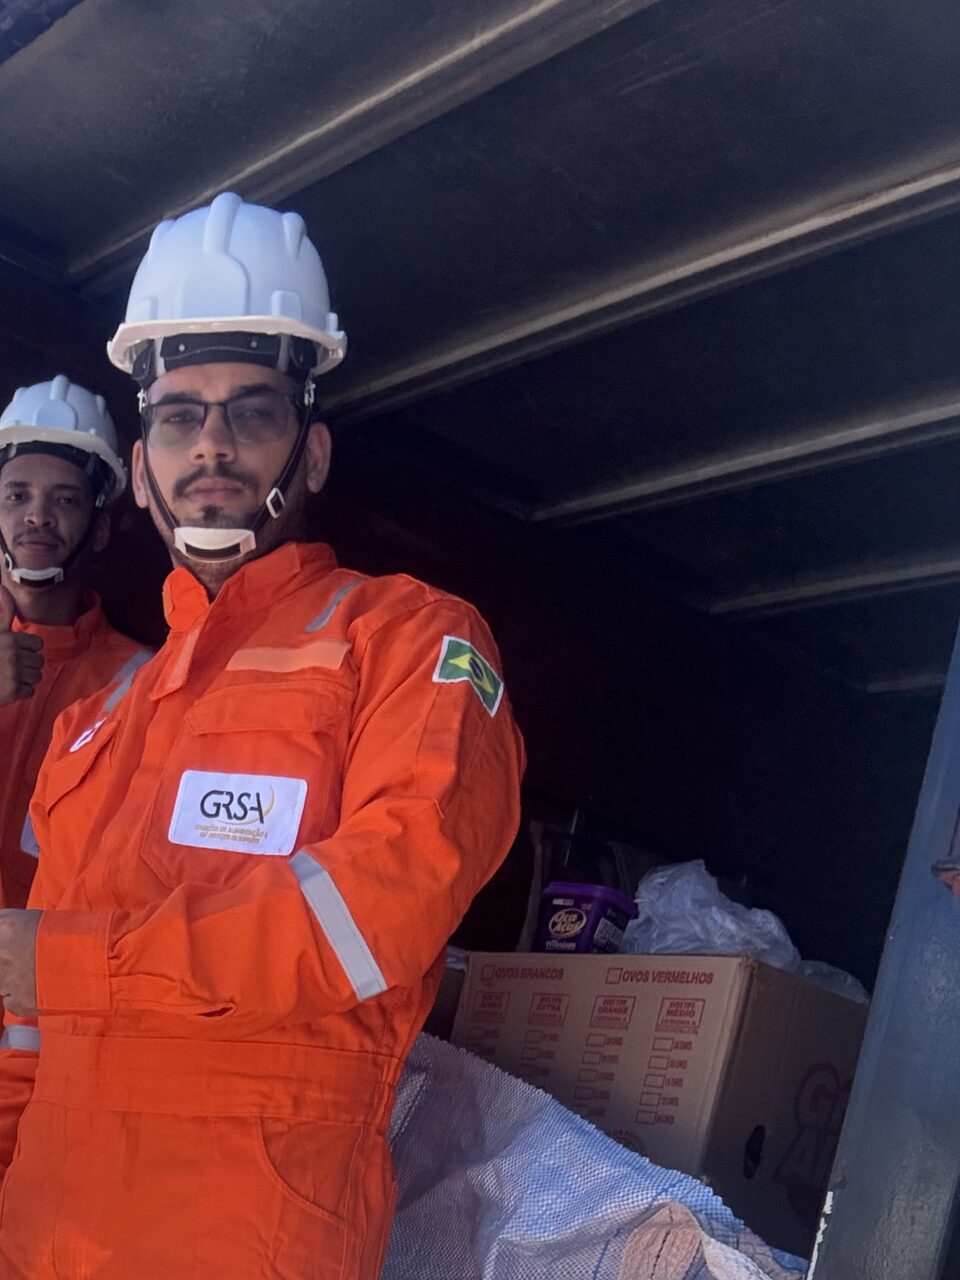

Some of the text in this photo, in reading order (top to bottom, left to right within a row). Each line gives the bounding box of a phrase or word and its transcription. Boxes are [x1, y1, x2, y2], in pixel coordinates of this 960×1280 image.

[199, 789, 265, 824] GRSA
[495, 967, 565, 980] OVOS BRANCOS
[622, 970, 714, 984] OVOS VERMELHOS
